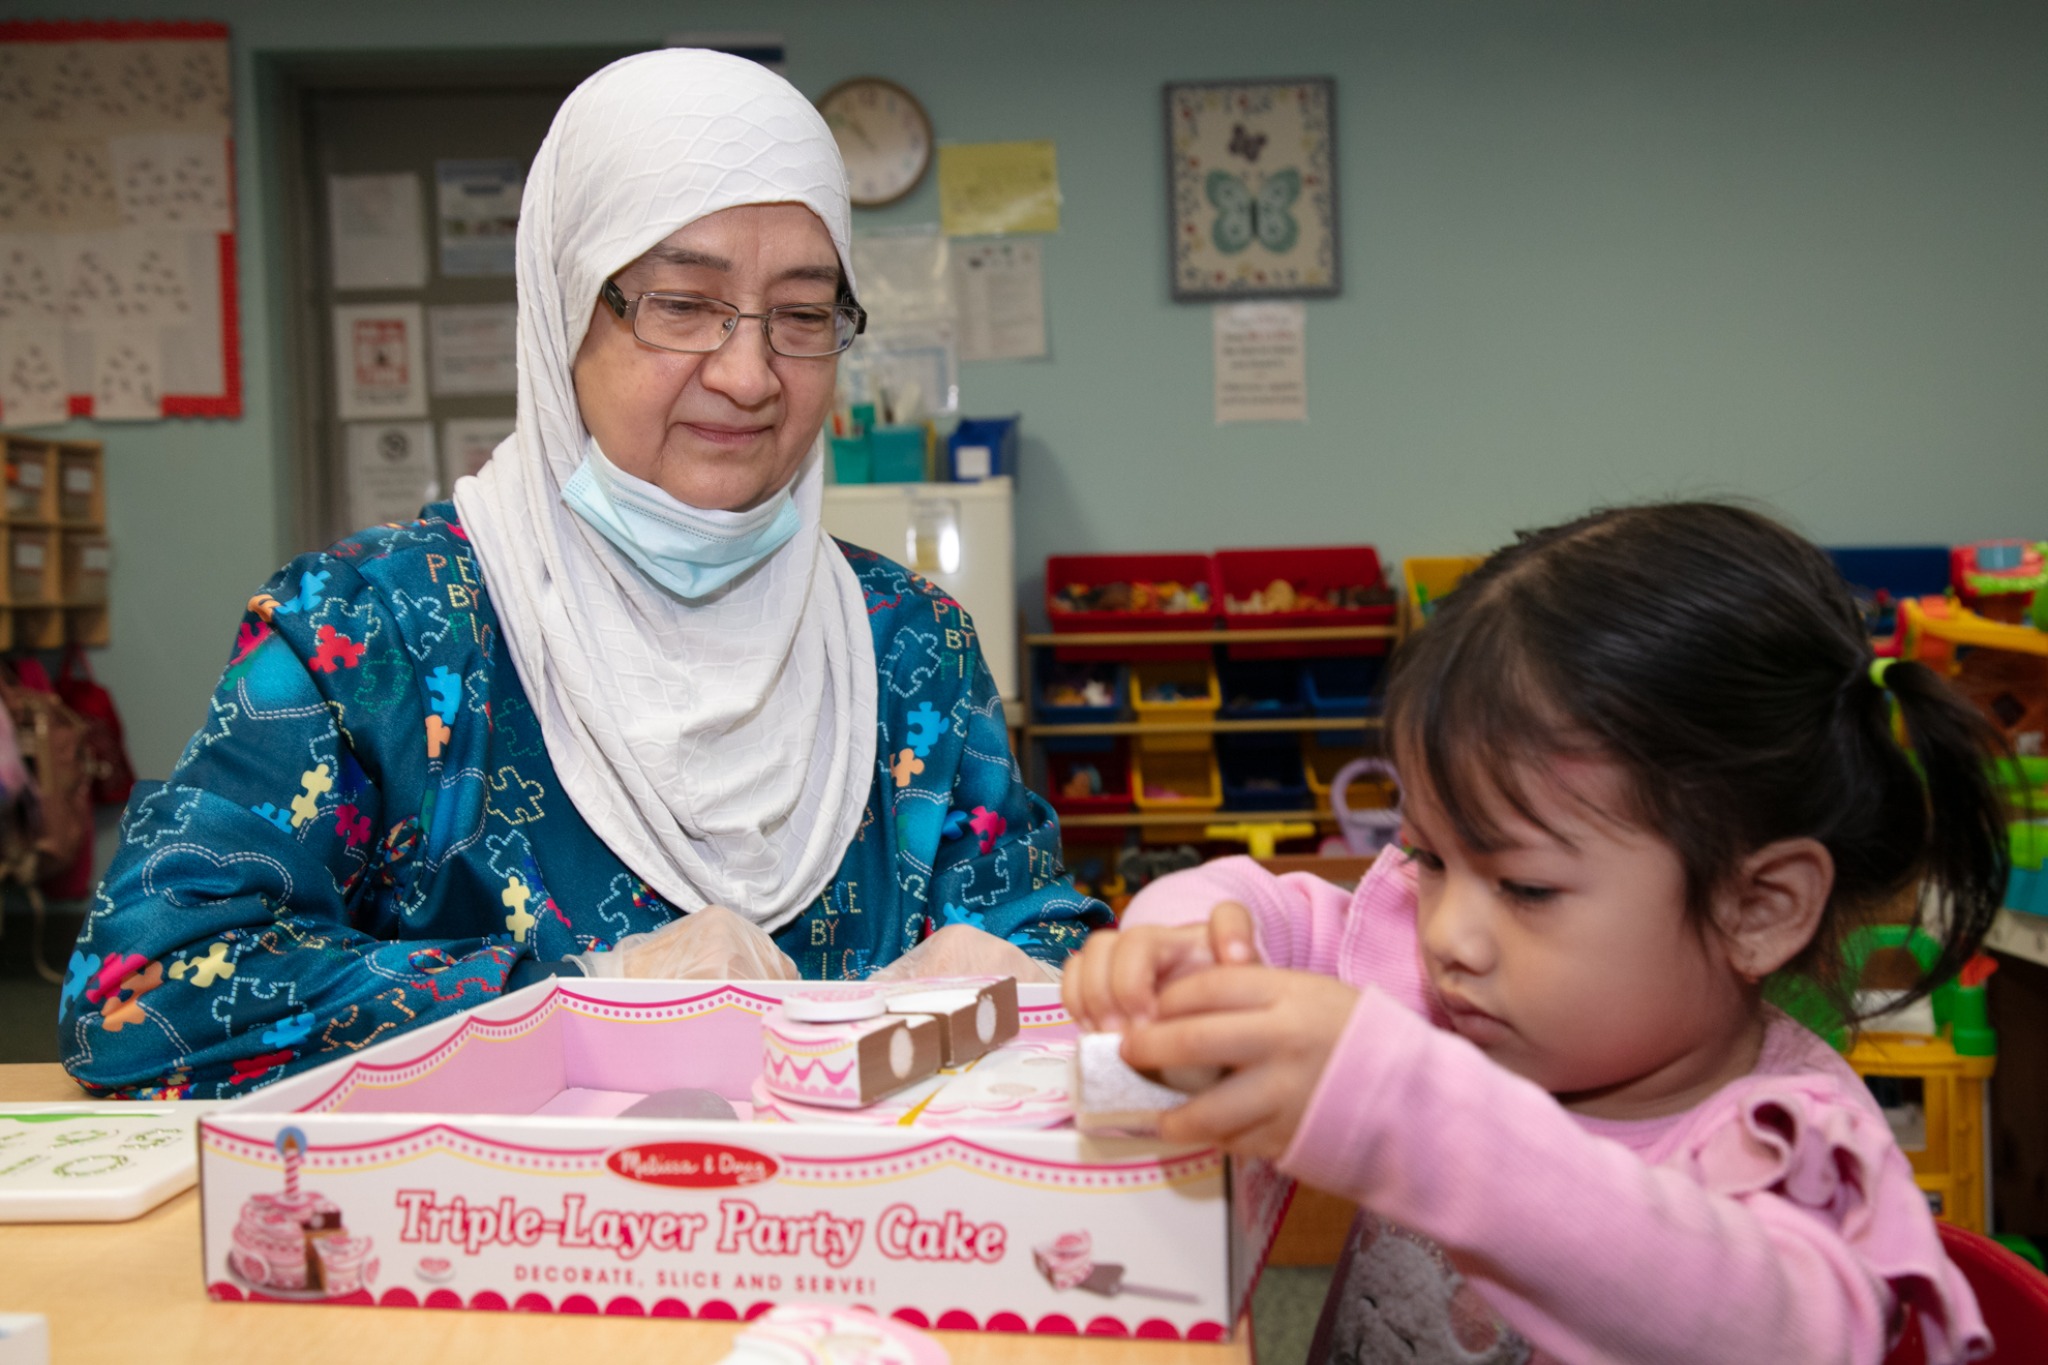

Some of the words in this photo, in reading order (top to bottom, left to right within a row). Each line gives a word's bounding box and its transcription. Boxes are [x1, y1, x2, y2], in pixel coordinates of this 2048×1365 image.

[447, 584, 480, 611] BY
[945, 628, 976, 652] BY
[811, 918, 840, 947] BY
[803, 948, 871, 981] PIECE
[619, 1150, 699, 1180] Melissa
[717, 1151, 767, 1186] Doug
[396, 1189, 708, 1261] Triple-Layer
[716, 1198, 866, 1270] Party
[876, 1202, 1008, 1265] Cake
[514, 1264, 645, 1289] DECORATE,
[656, 1269, 721, 1290] SLICE
[733, 1273, 783, 1292] AND
[795, 1275, 877, 1296] SERVE!
